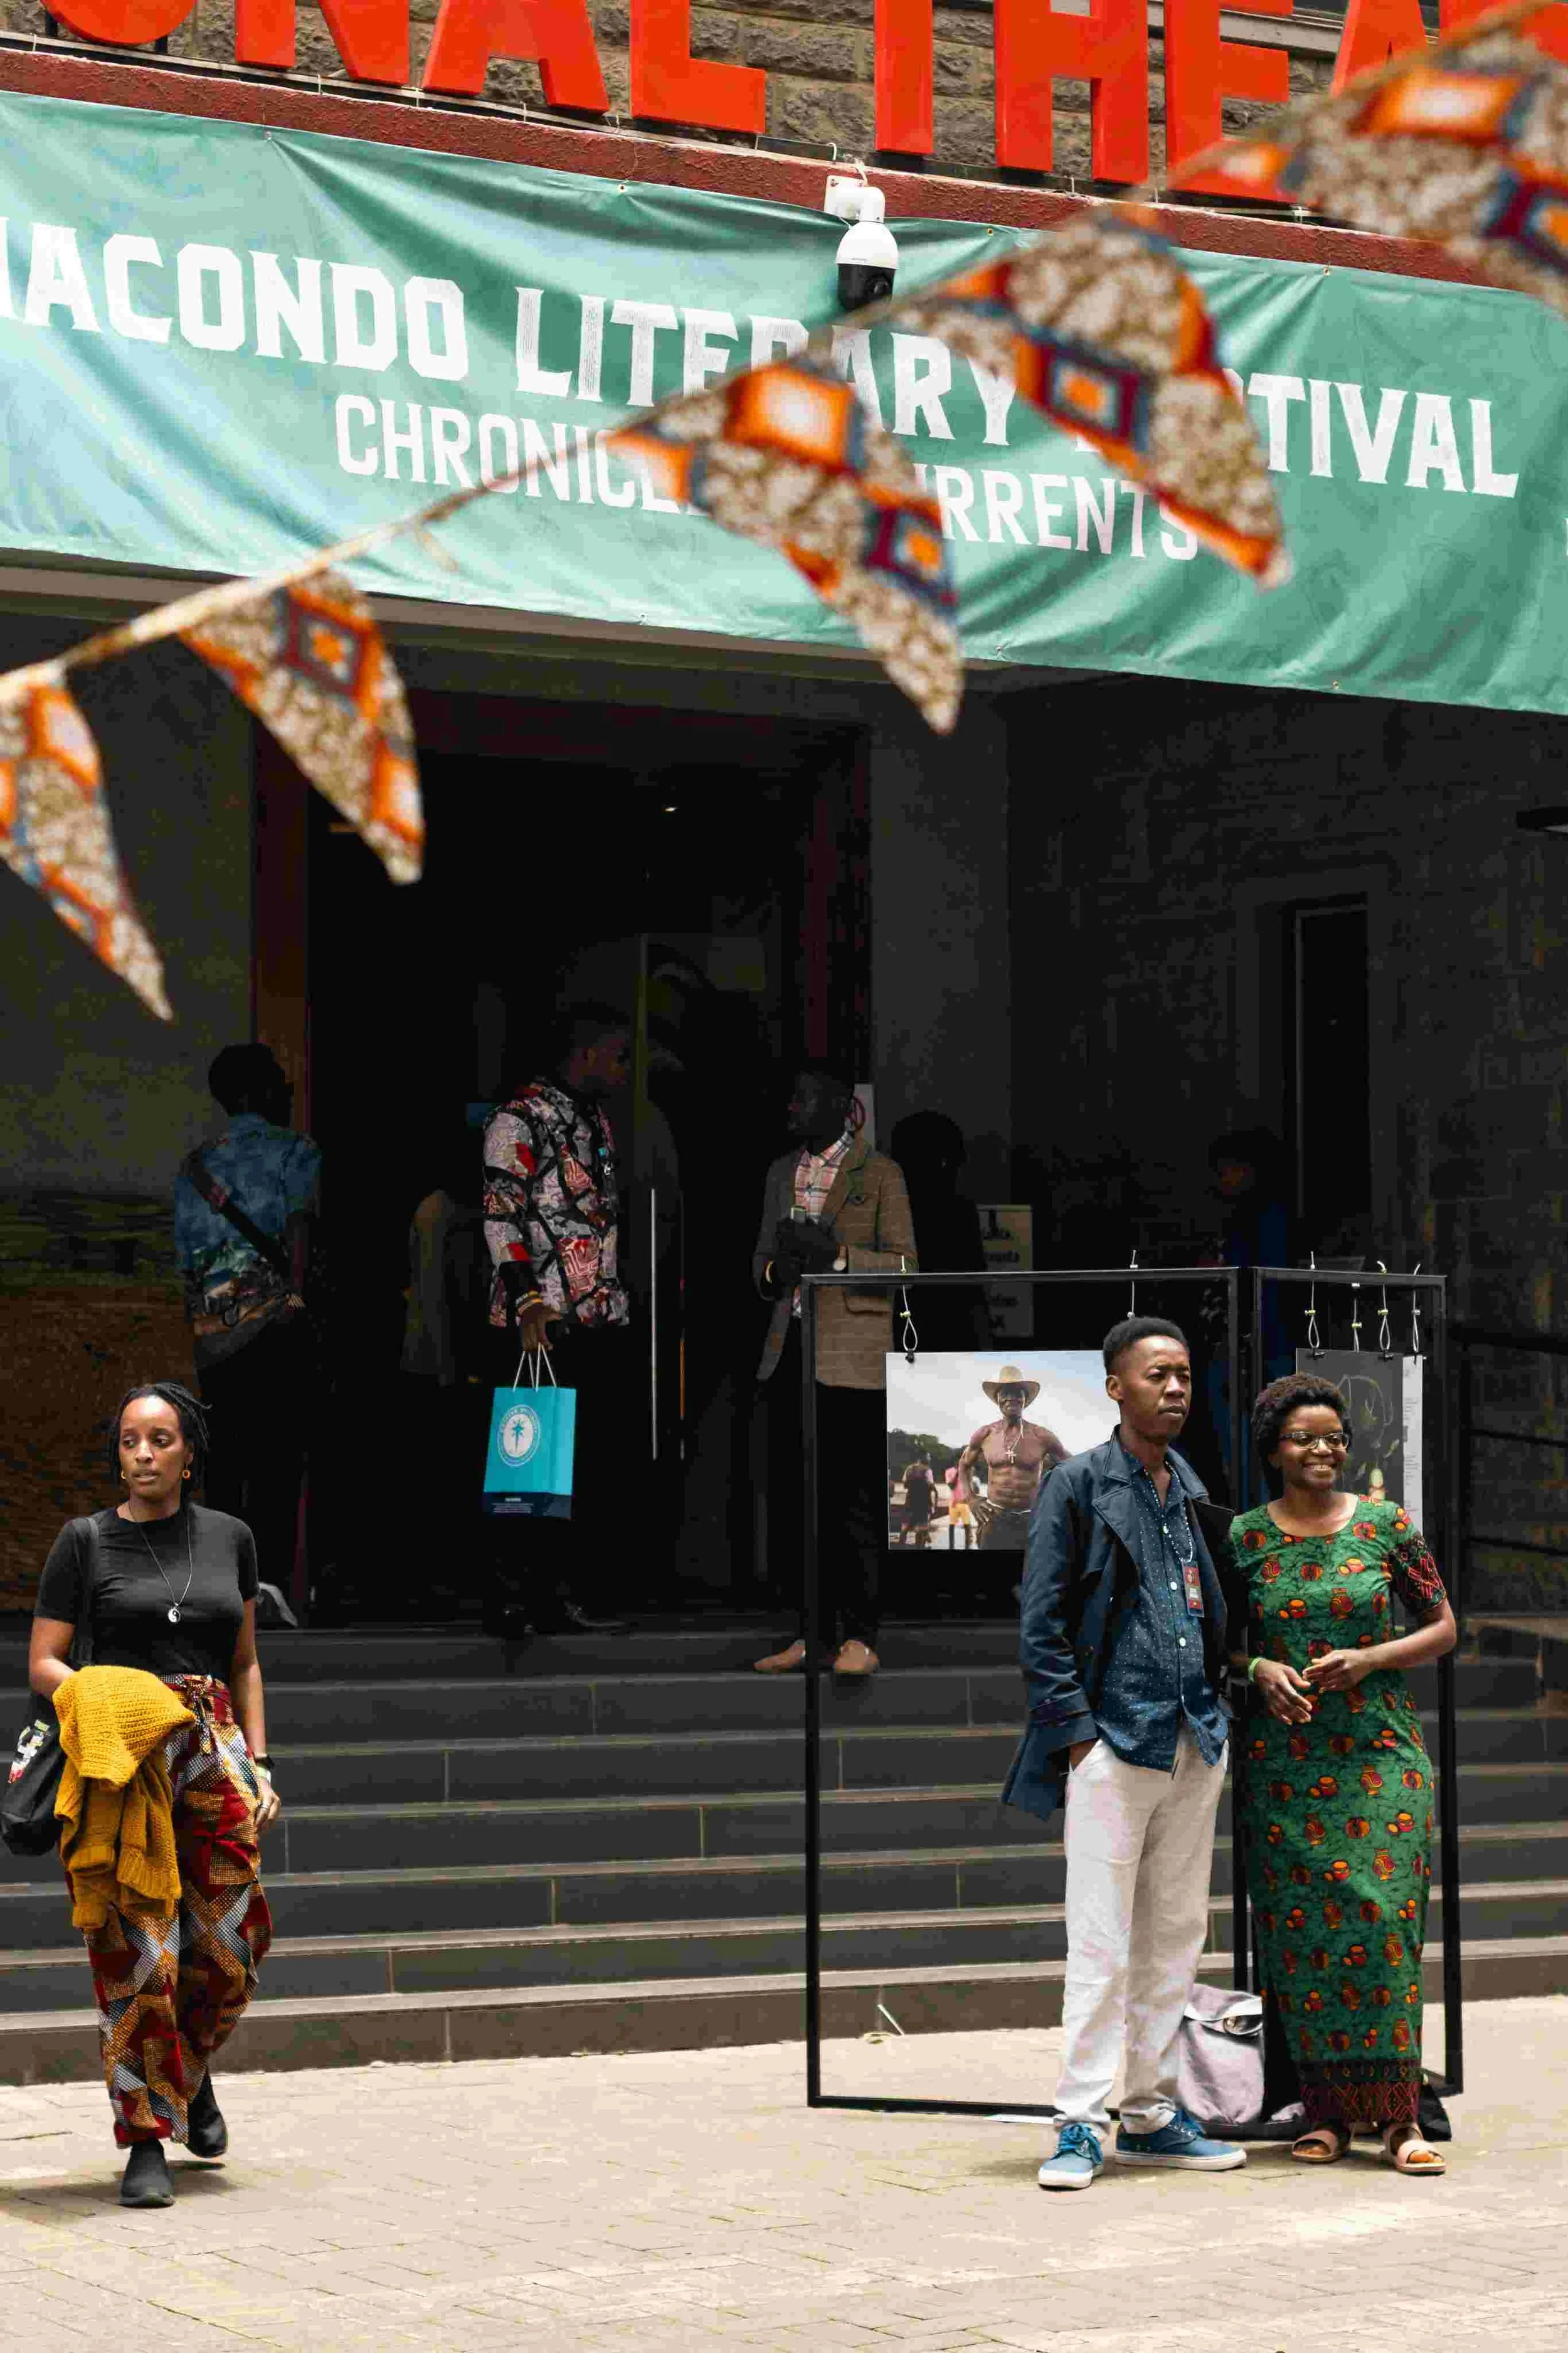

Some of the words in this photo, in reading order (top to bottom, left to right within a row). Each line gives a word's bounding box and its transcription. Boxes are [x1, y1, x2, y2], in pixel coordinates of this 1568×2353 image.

[0, 216, 469, 381] ACONDO
[335, 394, 709, 516] CHRONICL
[913, 463, 1199, 561] RRENTS
